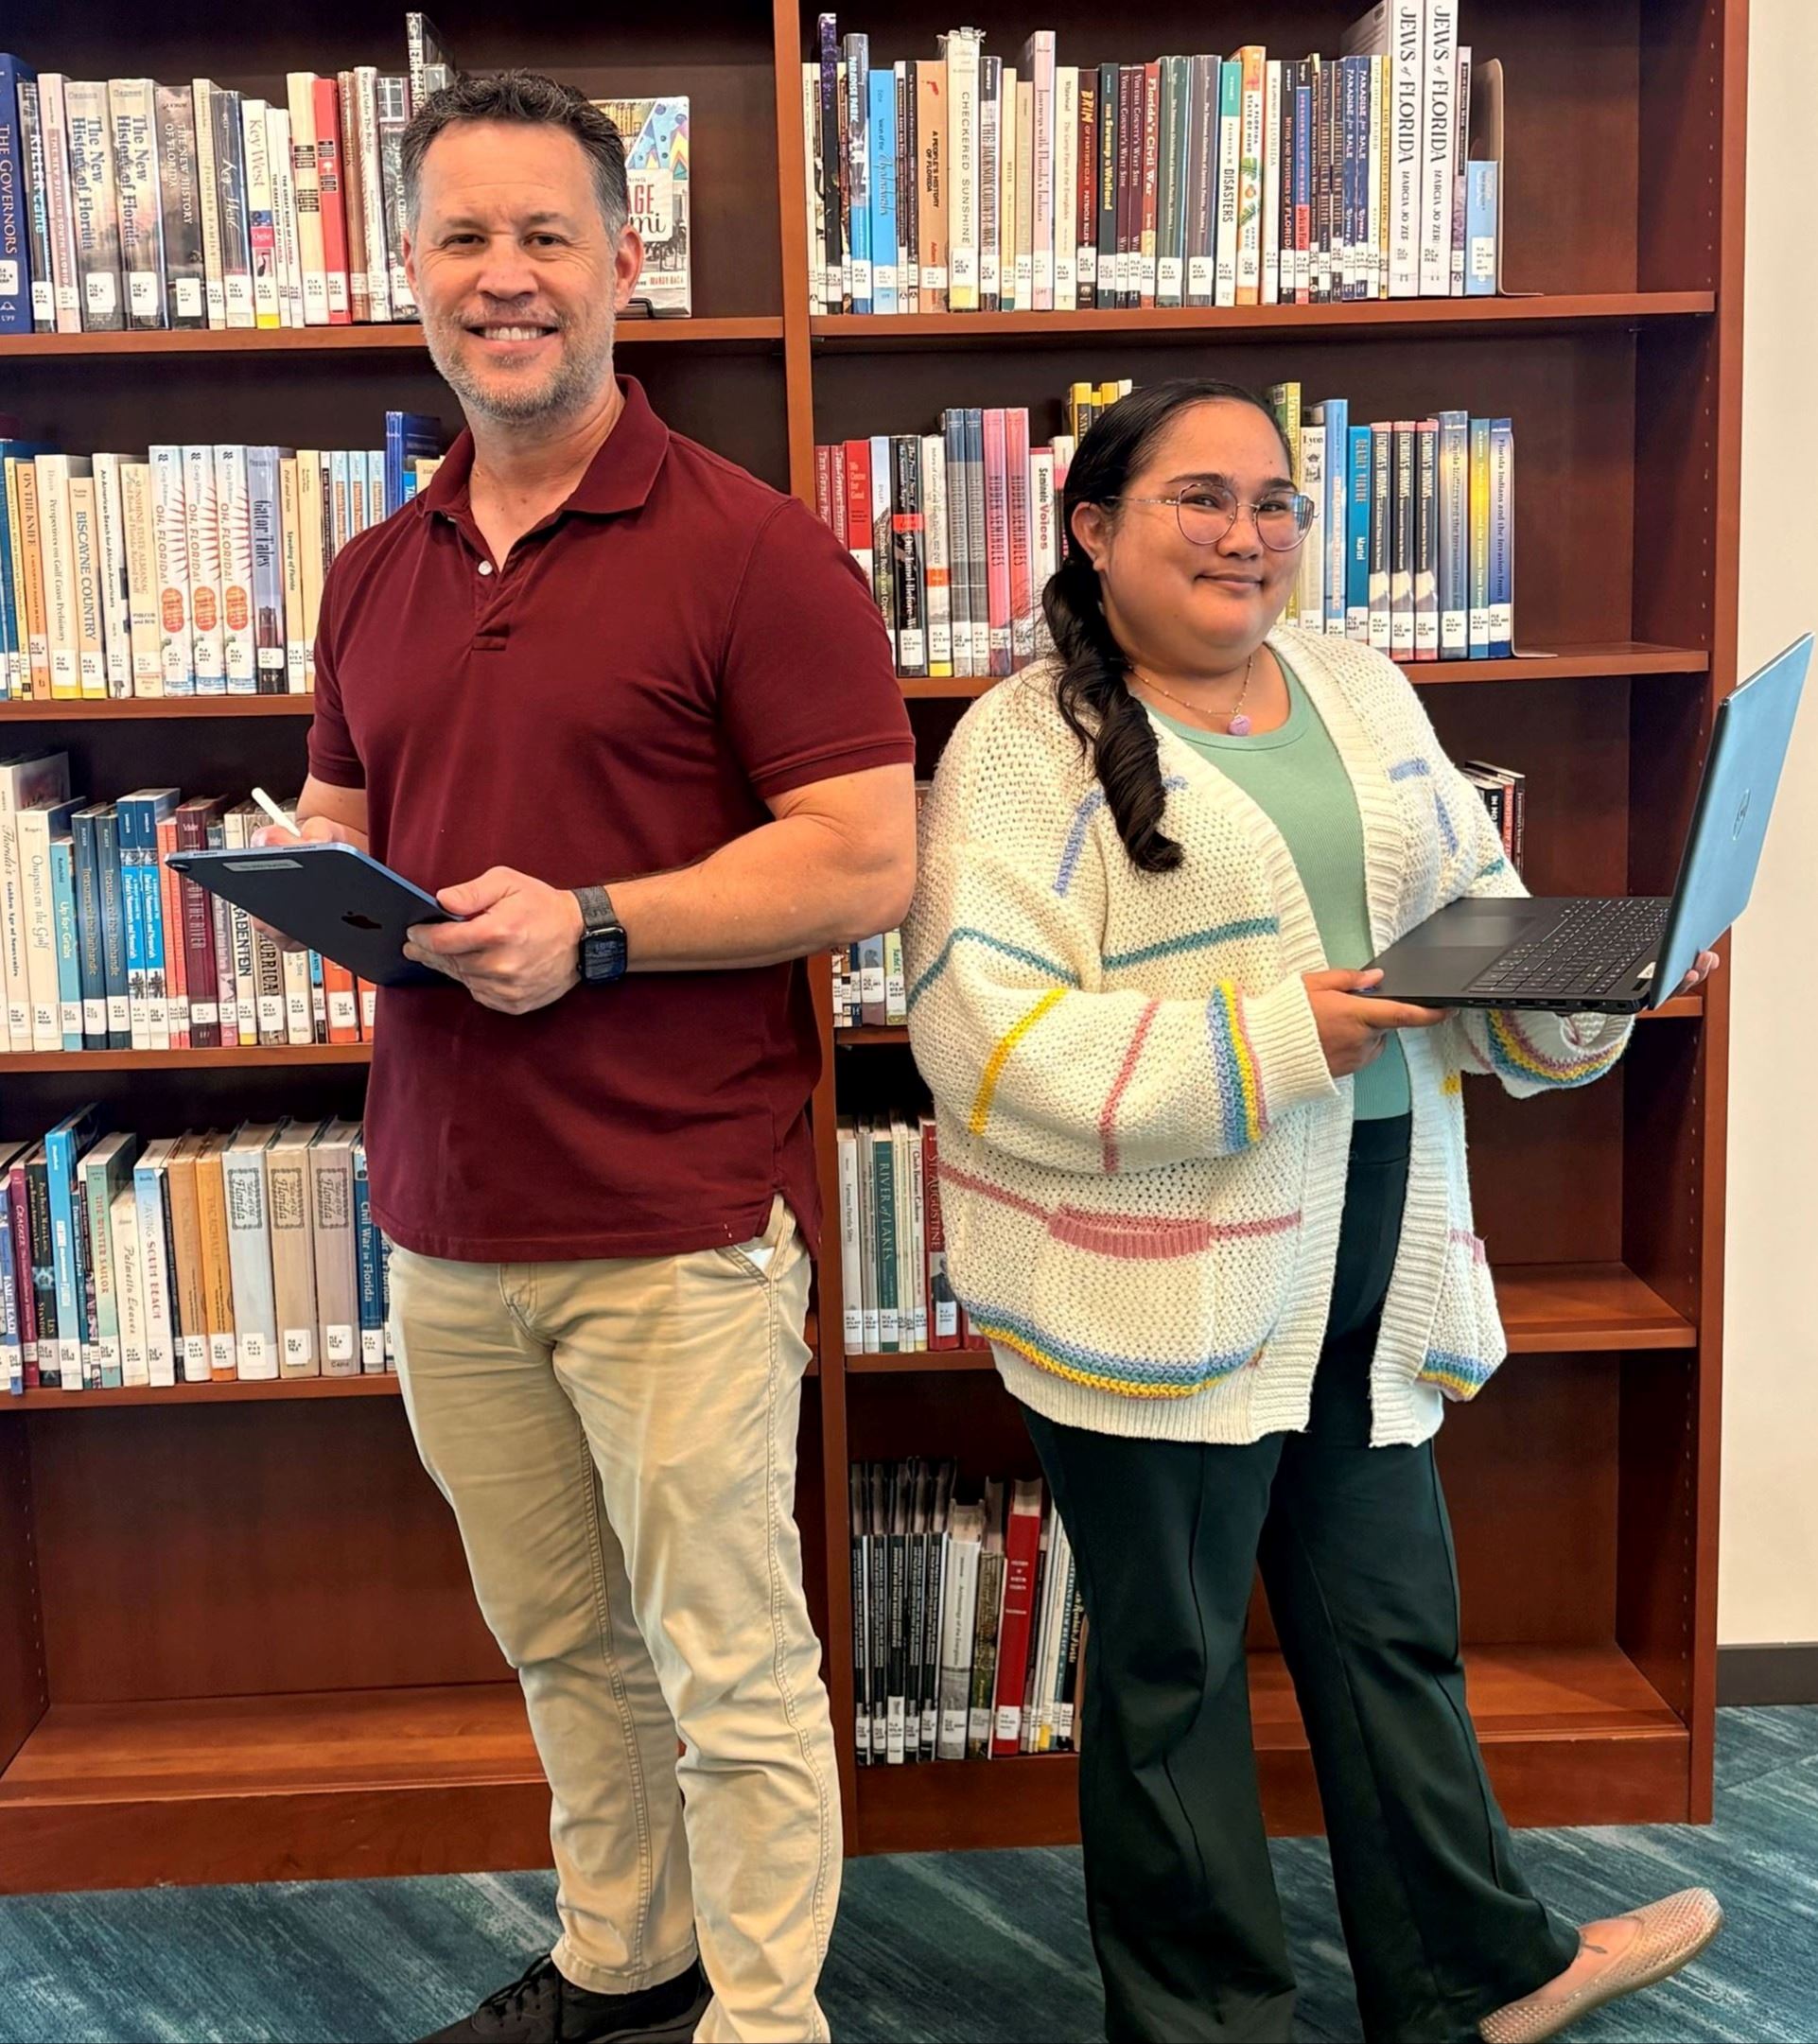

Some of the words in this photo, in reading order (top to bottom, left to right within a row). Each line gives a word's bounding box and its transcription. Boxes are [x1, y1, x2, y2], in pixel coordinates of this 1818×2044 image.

[1400, 6, 1417, 61] JEWS
[1433, 7, 1450, 61] JEWS
[848, 57, 858, 95] PARADISE
[1400, 66, 1411, 77] of
[1433, 65, 1444, 76] of
[849, 96, 859, 123] PARK
[1035, 89, 1049, 127] Journeys
[1080, 90, 1094, 123] BRIM
[1146, 78, 1156, 132] Florida's
[87, 117, 102, 146] The
[132, 115, 148, 145] The
[248, 119, 265, 150] Key
[961, 91, 970, 170] CHECKERED
[983, 122, 996, 142] THE
[1247, 119, 1252, 131] OF
[1398, 81, 1416, 165] FLORIDA
[1430, 80, 1447, 163] FLORIDA
[0, 125, 10, 155] THE
[72, 117, 88, 173] History
[115, 115, 132, 172] History
[926, 148, 932, 159] OF
[1038, 129, 1048, 148] with
[1146, 136, 1156, 167] Civil
[91, 151, 104, 183] New
[135, 149, 149, 182] New
[166, 142, 178, 187] FLORIDA
[252, 151, 267, 187] West
[982, 144, 996, 187] JACKSON
[1037, 149, 1050, 187] Florida's
[76, 178, 89, 193] of
[121, 175, 134, 189] of
[1145, 170, 1154, 197] War
[1401, 171, 1409, 206] MARCIA
[1433, 170, 1442, 205] MARCIA
[961, 179, 971, 244] SUNSHINE
[982, 189, 996, 224] COUNTY
[1037, 189, 1048, 222] Indians
[1401, 210, 1409, 221] JO
[1432, 208, 1442, 221] JO
[79, 197, 96, 250] Florida
[123, 195, 140, 248] Florida
[984, 227, 996, 248] WAR
[1355, 438, 1368, 469] DEADLY
[1375, 433, 1387, 467] FLORIDA'S
[1399, 433, 1410, 467] FLORIDA'S
[23, 473, 32, 488] ON
[100, 469, 107, 480] An
[1039, 467, 1050, 503] Seminole
[1355, 473, 1367, 503] VIRTUE
[1375, 469, 1388, 498] INDIANS
[1400, 469, 1411, 498] INDIANS
[25, 492, 34, 511] THE
[100, 480, 110, 513] American
[988, 477, 1002, 511] HIDDEN
[1010, 476, 1024, 511] HIDDEN
[103, 515, 112, 537] Beach
[155, 505, 165, 526] OH,
[187, 503, 198, 526] OH,
[220, 503, 229, 524] OH,
[253, 500, 272, 532] Gator
[1040, 505, 1050, 550] Voices
[26, 515, 36, 547] KNIFE
[76, 511, 89, 575] BISCAYNE
[286, 532, 295, 559] Speaking
[878, 522, 889, 557] Thatched
[990, 515, 1004, 568] SEMINOLES
[1012, 515, 1027, 567] SEMINOLES
[53, 548, 61, 558] on
[105, 548, 114, 571] African
[157, 531, 168, 584] FLORIDA!
[190, 529, 201, 583] FLORIDA!
[222, 528, 233, 582] FLORIDA!
[254, 533, 274, 568] Tales
[1355, 537, 1366, 560] Martel
[53, 560, 64, 577] Gulf
[880, 558, 890, 579] Roofs
[55, 579, 64, 602] Coast
[107, 573, 115, 607] Americans
[881, 581, 889, 594] and
[55, 602, 68, 642] Prehistory
[81, 577, 96, 640] COUNTRY
[880, 596, 890, 617] Open
[1491, 795, 1498, 806] IN
[1491, 807, 1498, 819] NO
[1, 825, 19, 876] Florida's
[27, 855, 44, 895] Outposts
[34, 897, 42, 908] on
[34, 912, 47, 924] the
[61, 901, 69, 916] Up
[189, 902, 202, 920] THE
[7, 912, 15, 925] Age
[9, 927, 16, 936] of
[32, 927, 50, 952] Gulf
[62, 933, 72, 959] Grabs
[190, 923, 206, 950] RIVER
[9, 938, 19, 976] Souvenirs
[912, 1151, 920, 1169] Clash
[845, 1183, 853, 1206] Famous
[879, 1163, 892, 1201] RIVER
[912, 1170, 921, 1196] Between
[96, 1196, 105, 1214] THE
[233, 1179, 247, 1220] Florida
[276, 1179, 289, 1220] Florida
[322, 1179, 334, 1219] Florida
[361, 1201, 373, 1224] Civil
[880, 1206, 891, 1216] of
[914, 1197, 922, 1223] Cultures
[846, 1208, 854, 1228] Florida
[96, 1218, 108, 1254] WINTER
[362, 1228, 373, 1249] War
[881, 1219, 894, 1261] LAKES
[98, 1257, 110, 1294] SAILOR
[123, 1246, 136, 1294] Palmetto
[363, 1264, 375, 1302] Florida
[127, 1297, 139, 1335] Leaves
